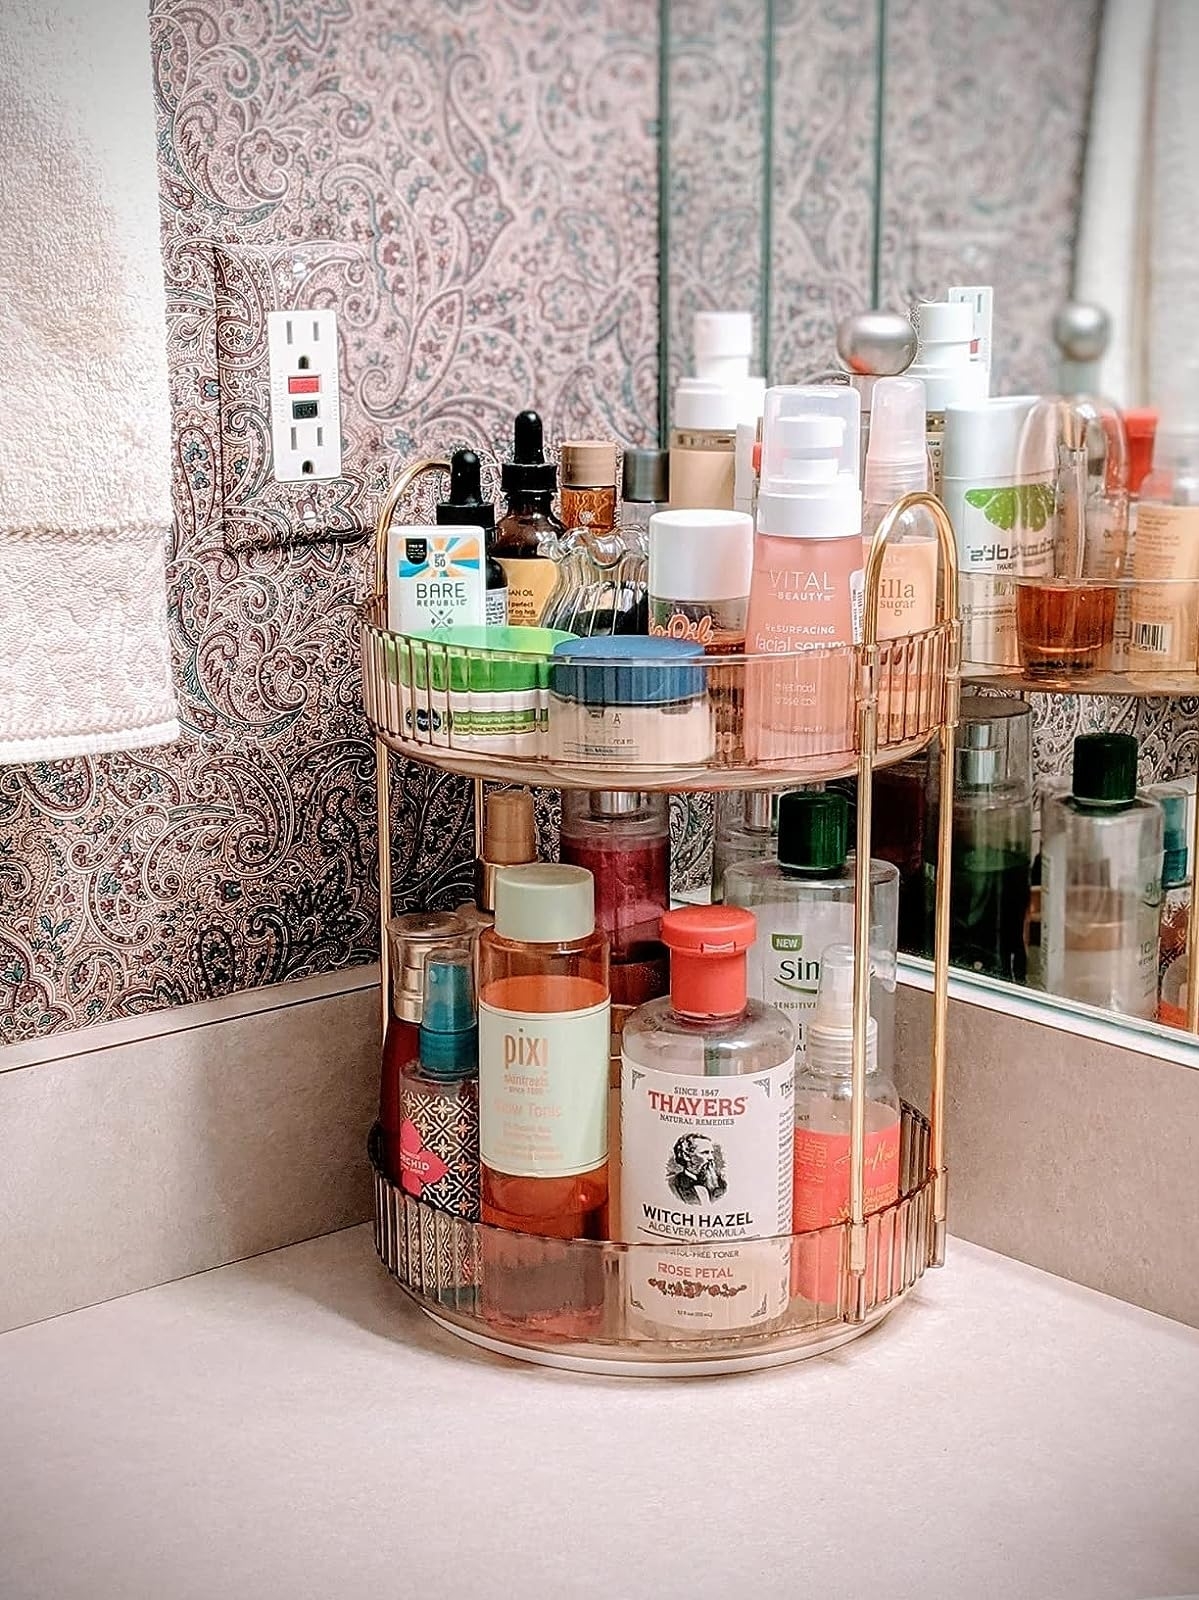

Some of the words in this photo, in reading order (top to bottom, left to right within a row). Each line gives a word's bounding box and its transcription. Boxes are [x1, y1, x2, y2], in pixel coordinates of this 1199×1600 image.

[434, 559, 446, 568] 50
[768, 569, 836, 591] VITAL
[416, 582, 465, 599] BARE
[777, 591, 823, 601] BEAUTY
[416, 599, 467, 607] REPUBLIC
[880, 600, 916, 617] sugar
[765, 624, 836, 635] RESURFACING
[755, 633, 791, 652] facial
[776, 937, 799, 949] NEW
[504, 1028, 548, 1069] pixi
[674, 1086, 698, 1096] SINCE
[701, 1089, 720, 1097] 1847
[647, 1089, 746, 1117] THAYERS
[659, 1113, 693, 1125] NATURAL
[695, 1118, 735, 1126] REMEDIES
[400, 1152, 430, 1171] RCHID
[642, 1203, 694, 1227] WITCH
[699, 1211, 753, 1228] HAZEL
[648, 1221, 672, 1231] ALOE
[672, 1226, 697, 1238] VERA
[700, 1227, 746, 1238] FORMULA
[713, 1250, 740, 1259] TONER
[657, 1262, 691, 1277] ROSE
[695, 1267, 734, 1278] PETAL
